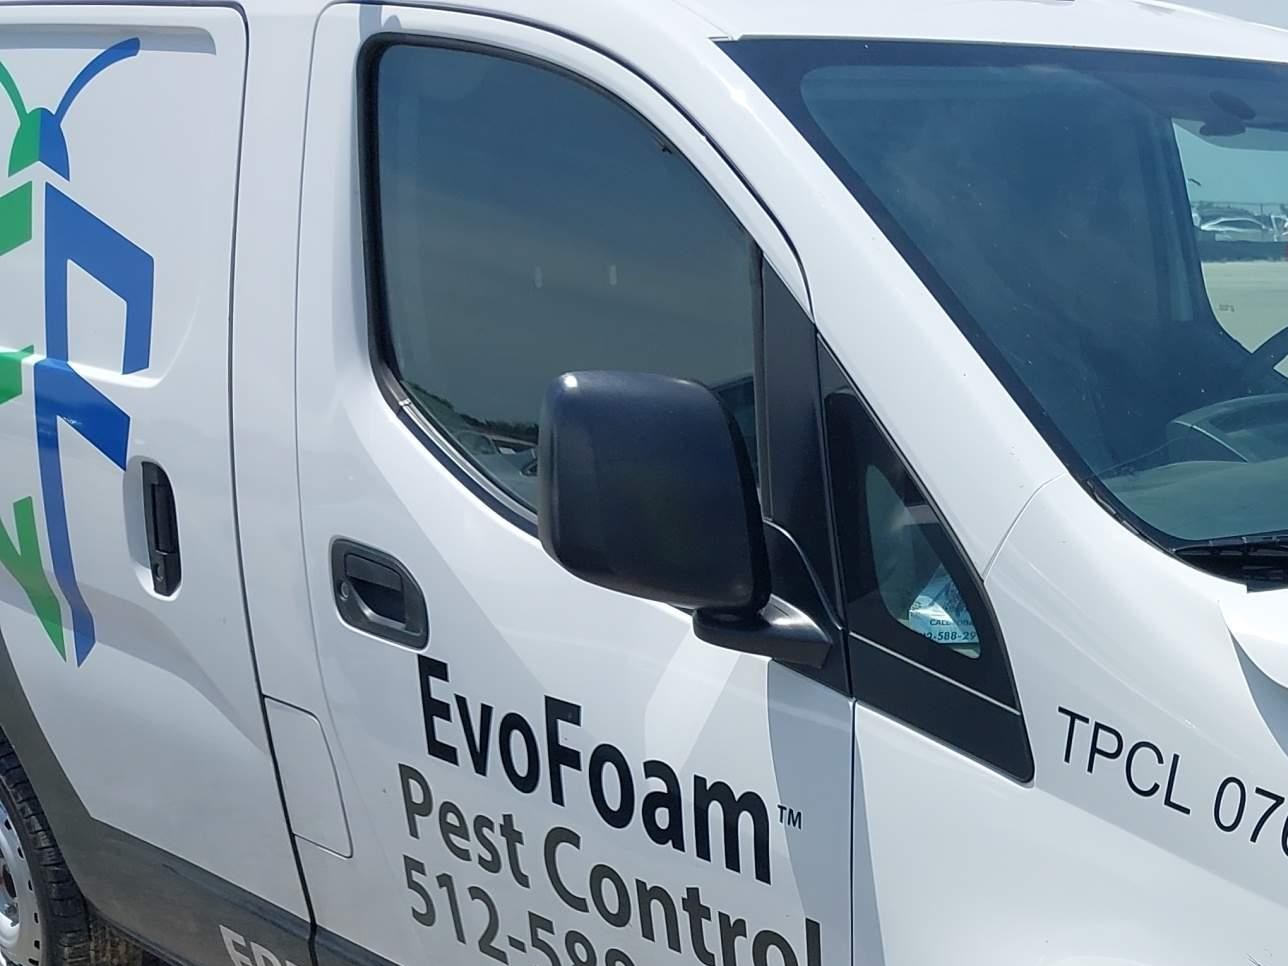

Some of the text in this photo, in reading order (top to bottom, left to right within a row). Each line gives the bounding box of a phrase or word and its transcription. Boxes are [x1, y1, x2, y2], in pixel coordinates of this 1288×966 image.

[417, 653, 772, 885] EvoFoam
[1058, 706, 1191, 815] TPCL
[398, 763, 530, 888] Pest
